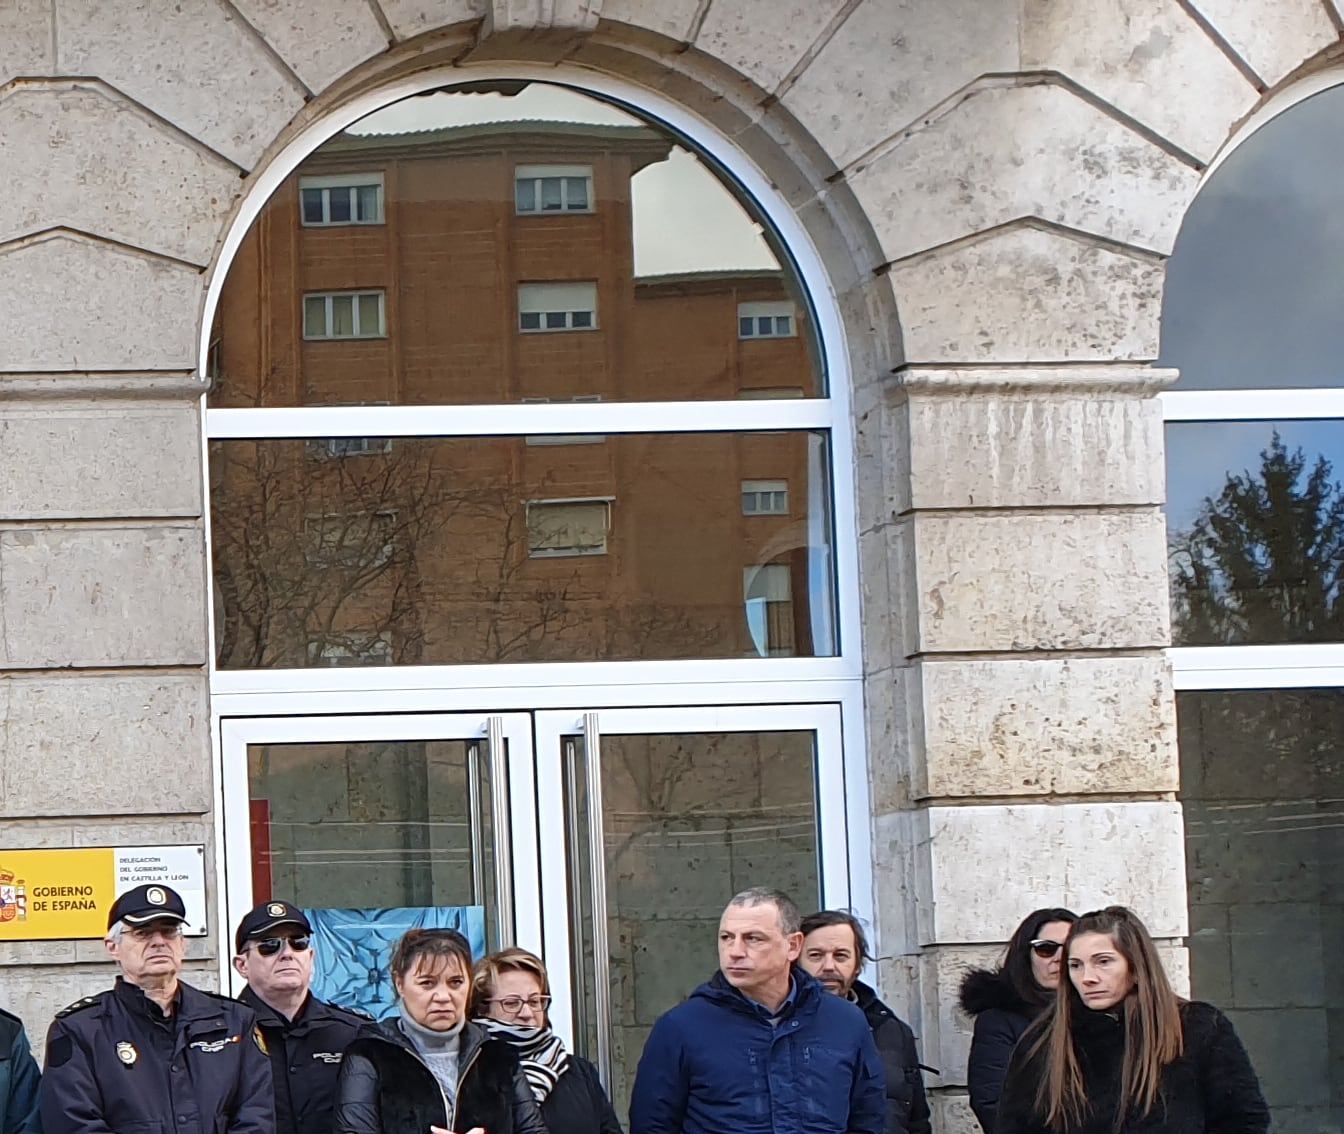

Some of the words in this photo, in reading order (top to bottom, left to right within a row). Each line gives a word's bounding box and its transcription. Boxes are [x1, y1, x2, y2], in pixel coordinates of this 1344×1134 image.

[33, 886, 93, 897] GOBIERNO
[33, 901, 48, 911] DE
[52, 898, 97, 910] ESPAÑA
